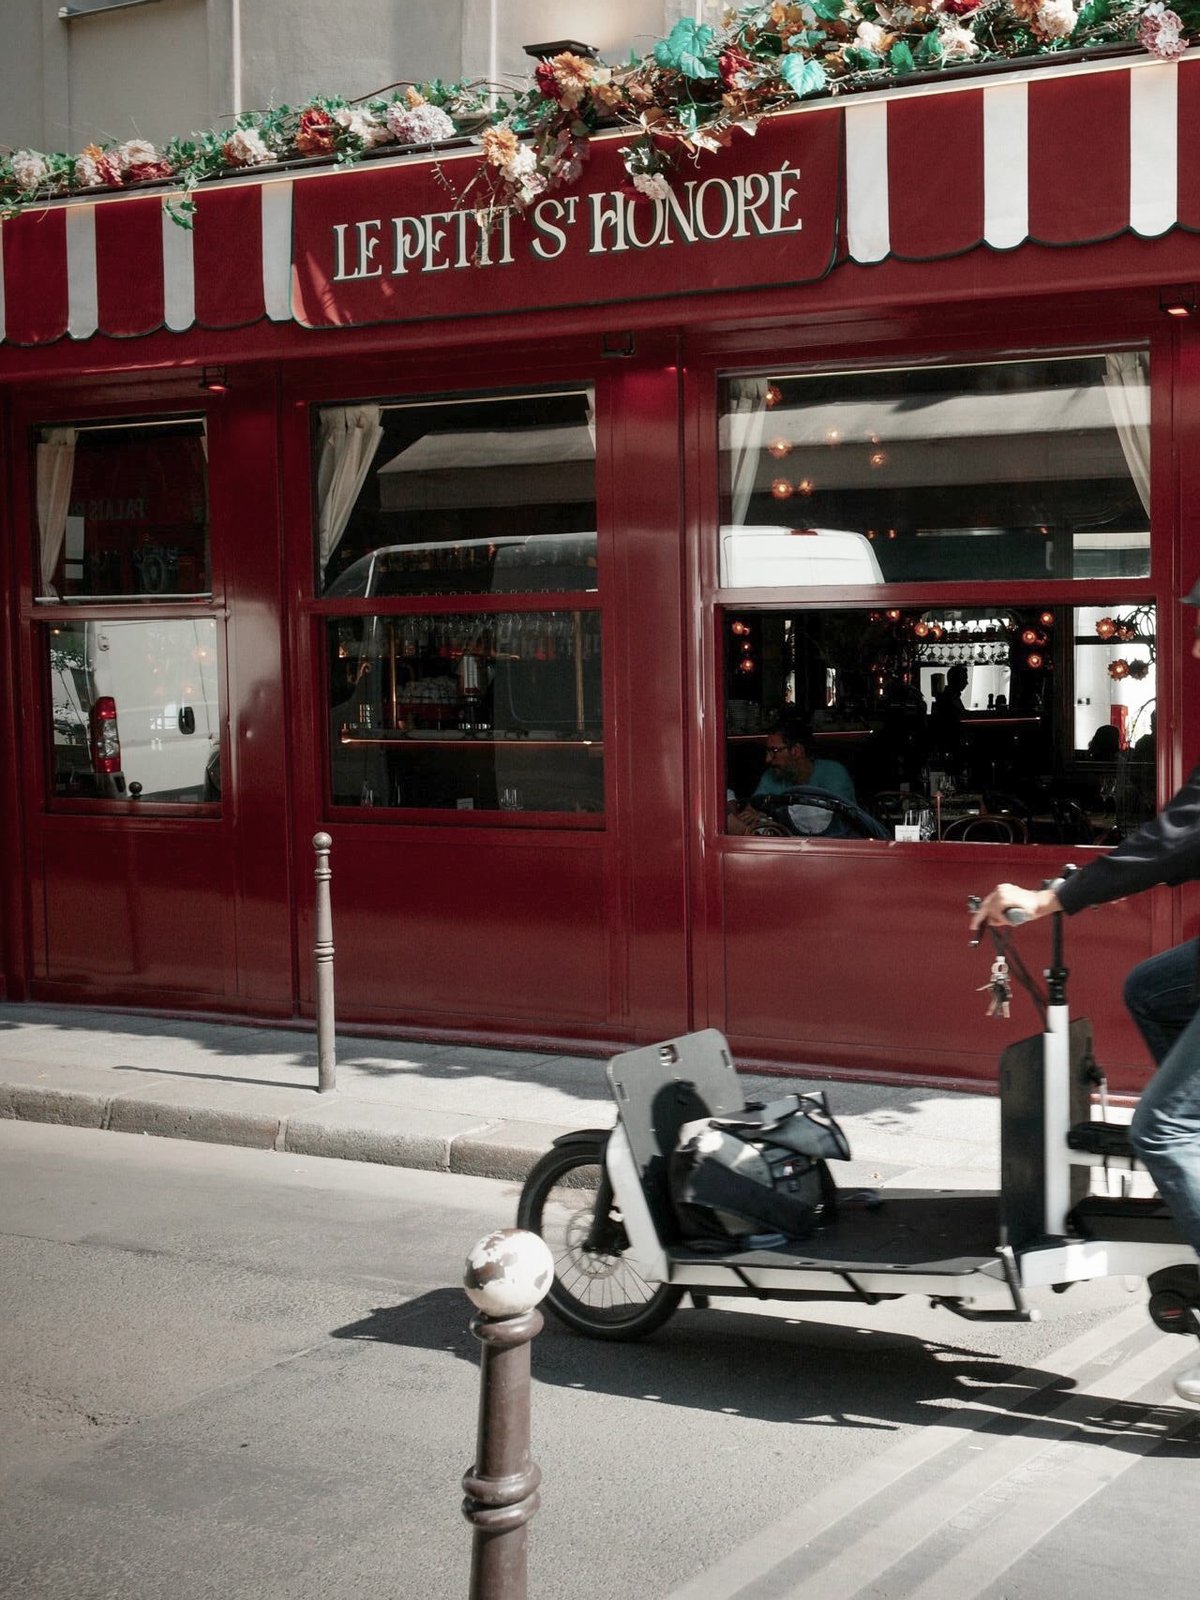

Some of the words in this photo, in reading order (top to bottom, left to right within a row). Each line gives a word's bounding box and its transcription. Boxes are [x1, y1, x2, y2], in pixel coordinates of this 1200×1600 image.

[333, 220, 383, 281] LE
[391, 204, 516, 275] PETIT
[588, 160, 803, 253] HONORÉ
